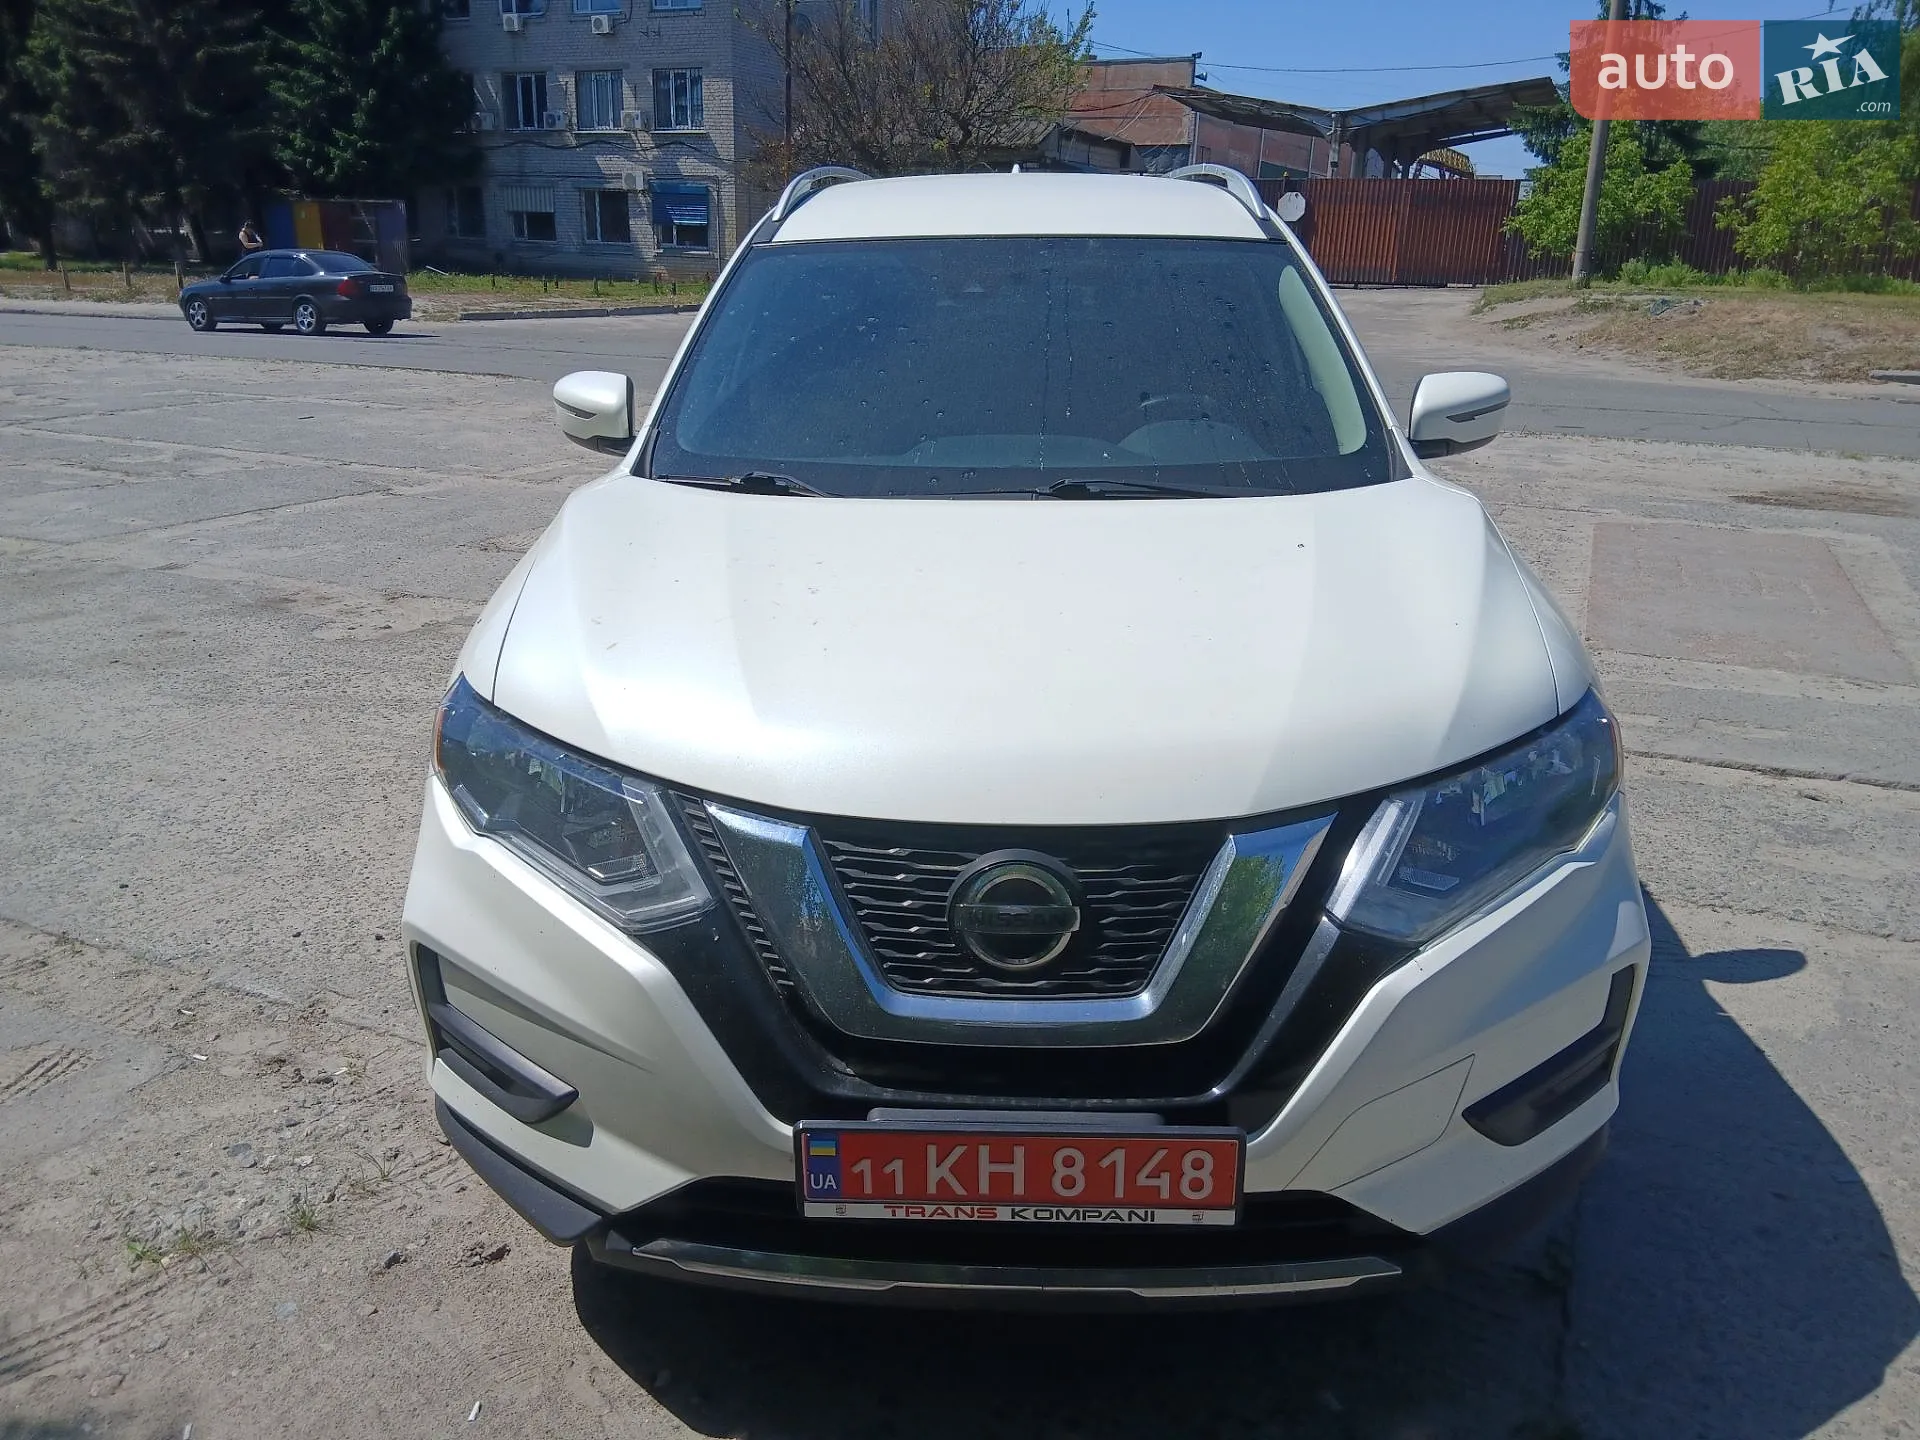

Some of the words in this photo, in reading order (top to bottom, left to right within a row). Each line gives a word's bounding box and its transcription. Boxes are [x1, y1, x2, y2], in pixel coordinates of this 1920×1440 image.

[850, 1158, 904, 1195] 11
[926, 1143, 1026, 1196] KH
[1051, 1147, 1215, 1200] 8148
[809, 1173, 838, 1190] UA
[883, 1204, 998, 1220] TRANS
[1010, 1207, 1156, 1223] KOMPANI
